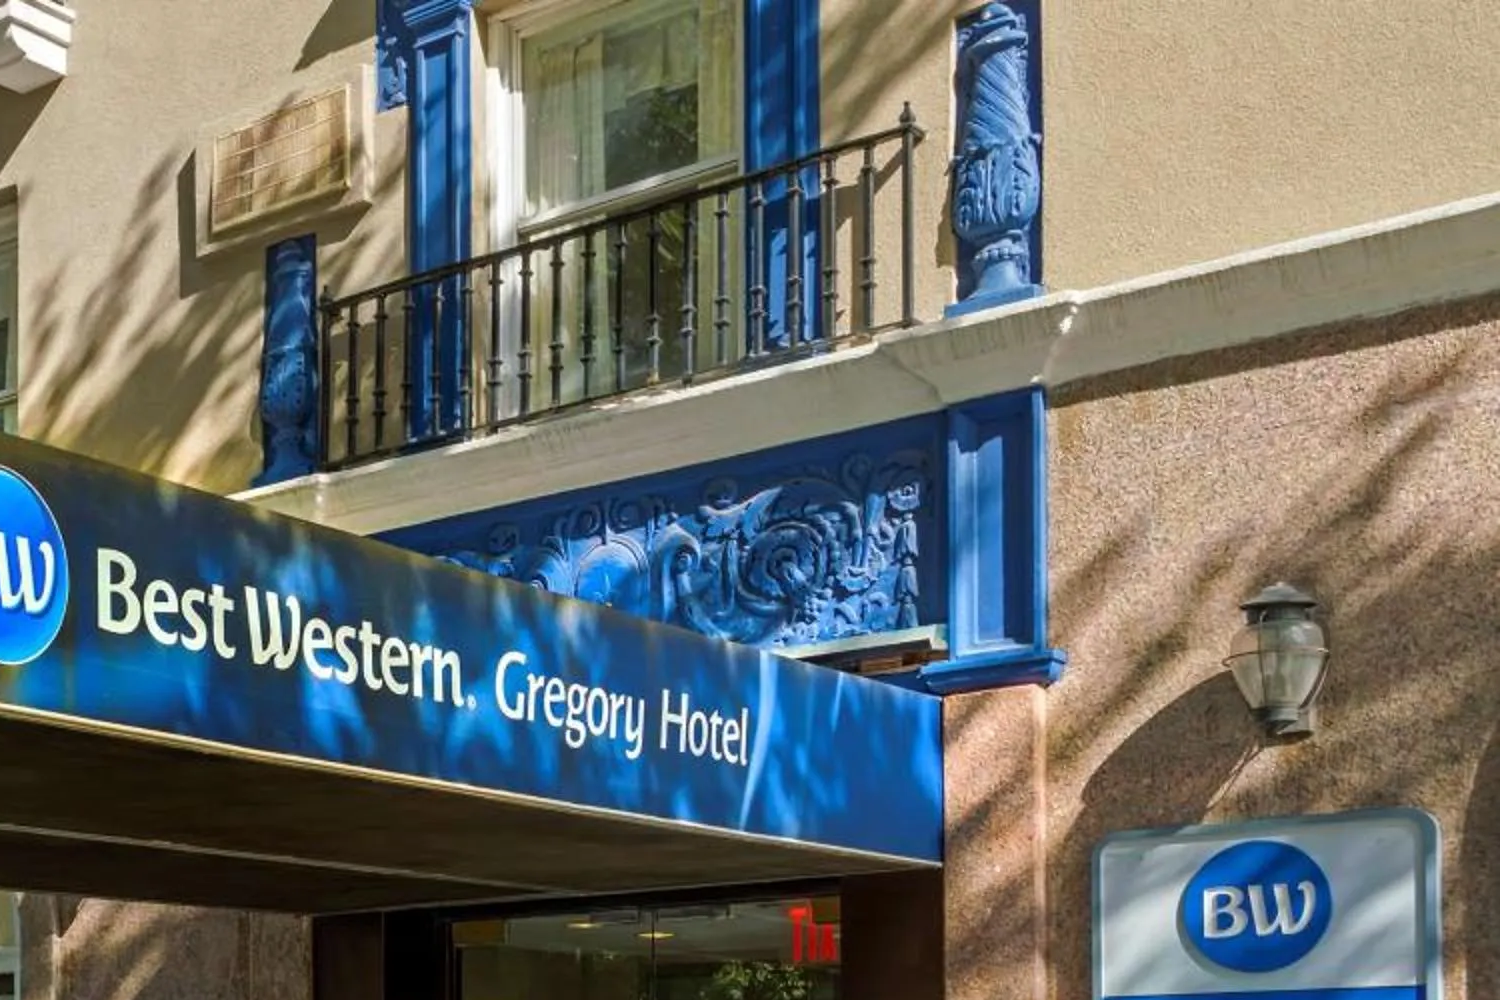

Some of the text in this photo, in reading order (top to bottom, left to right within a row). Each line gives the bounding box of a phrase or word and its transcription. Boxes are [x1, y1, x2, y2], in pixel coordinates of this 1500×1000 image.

[96, 547, 236, 653] Best
[494, 650, 646, 765] Gregory
[660, 689, 749, 767] Hotel
[1203, 880, 1316, 939] BW
